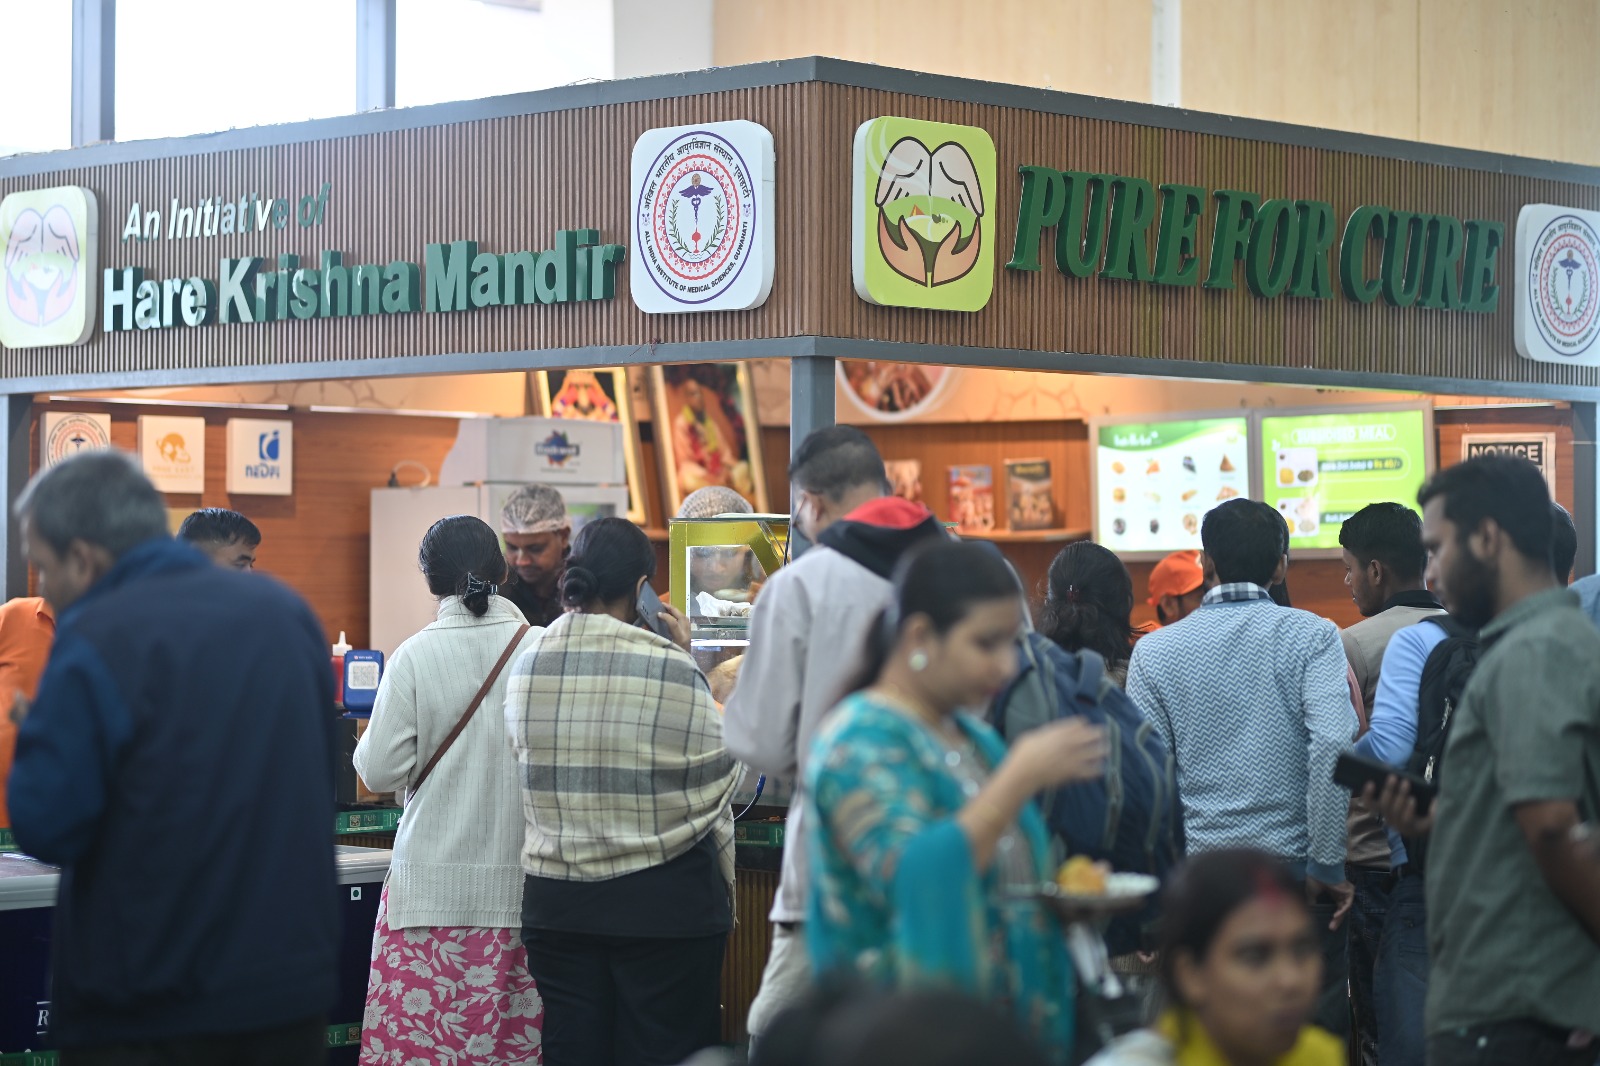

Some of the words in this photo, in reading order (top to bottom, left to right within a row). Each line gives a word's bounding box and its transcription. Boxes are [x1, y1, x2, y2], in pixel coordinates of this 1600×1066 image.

[656, 153, 675, 178] भारतीय
[122, 202, 161, 243] An
[168, 192, 289, 240] Initiative
[297, 182, 331, 228] of
[1005, 165, 1206, 286] PURE
[1202, 189, 1337, 300] FOR
[1339, 204, 1505, 314] CURE
[104, 266, 217, 332] Hare
[219, 250, 421, 324] Krishna
[426, 228, 626, 313] Mandir
[647, 245, 657, 265] INDIA
[655, 264, 679, 289] INSTITUTE
[687, 284, 711, 293] MEDICAL
[711, 262, 736, 288] SCIENCES,
[734, 221, 748, 260] GUWAHATI
[1471, 445, 1539, 462] NOTICE
